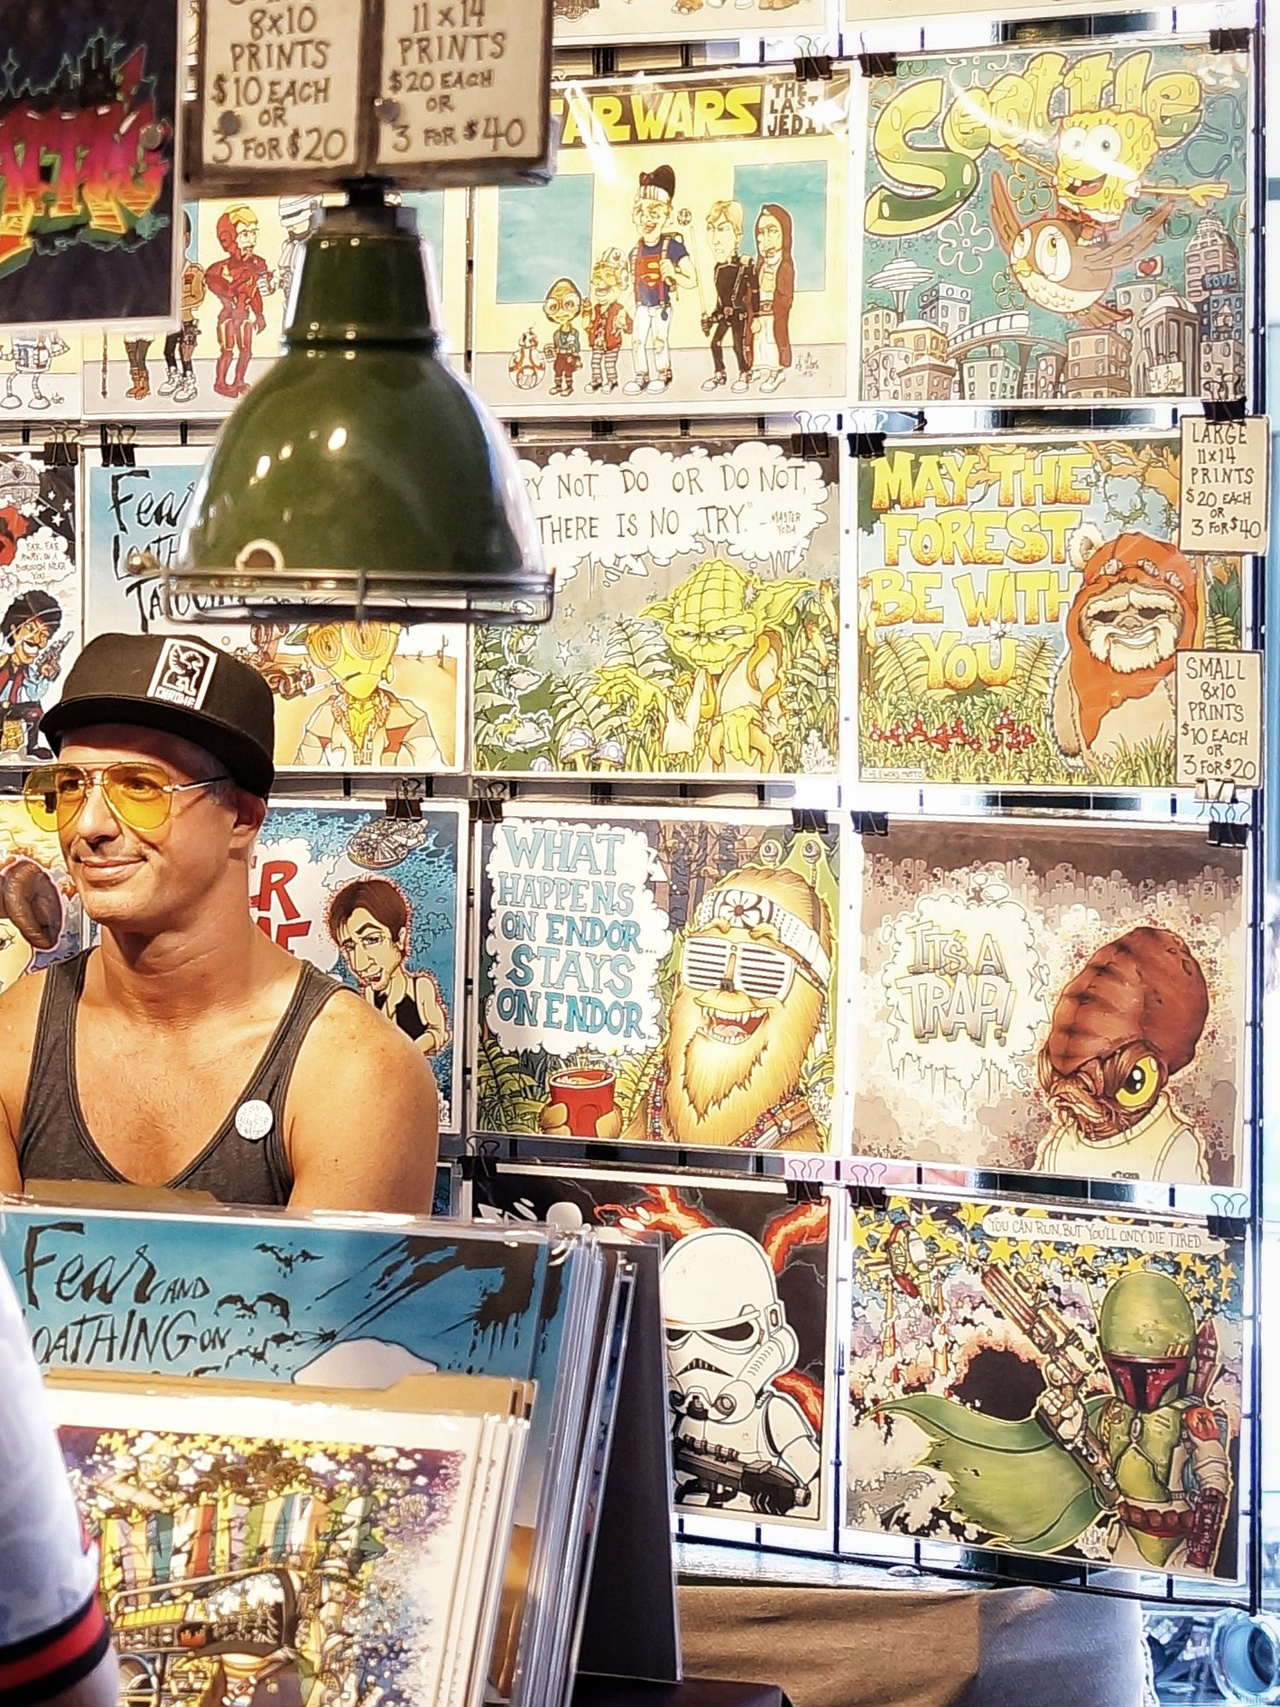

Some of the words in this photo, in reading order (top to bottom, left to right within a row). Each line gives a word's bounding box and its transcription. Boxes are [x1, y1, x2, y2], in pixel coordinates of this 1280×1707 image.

[249, 6, 317, 41] 8x10
[230, 40, 331, 72] PRINTS
[398, 31, 506, 66] PRINTS
[210, 74, 262, 107] $10
[268, 77, 330, 106] EACH
[389, 69, 434, 94] $20
[440, 69, 494, 90] EACH
[772, 82, 807, 99] THE
[258, 106, 288, 127] OR
[426, 95, 455, 113] OR
[631, 86, 762, 140] WARS
[242, 137, 283, 160] FOR
[287, 128, 346, 162] $20
[392, 124, 411, 152] 3
[423, 126, 457, 146] FOR
[463, 117, 525, 152] $40
[1192, 422, 1247, 445] LARGE
[1198, 447, 1236, 464] 11x14
[619, 469, 649, 494] DO
[672, 467, 704, 495] OR
[720, 464, 749, 491] DO
[870, 451, 979, 510] MAY
[989, 453, 1093, 507] THE
[1191, 467, 1254, 484] PRINTS
[1186, 487, 1217, 507] $20
[1222, 491, 1251, 505] EACH
[1210, 507, 1225, 518] OR
[535, 514, 599, 544] THERE
[616, 513, 638, 538] IS
[650, 506, 680, 538] NO
[880, 508, 1082, 566] FOREST
[1191, 519, 1204, 536] 3
[1209, 522, 1229, 534] FOR
[1230, 516, 1261, 539] $40
[867, 568, 944, 626] BE
[952, 568, 1083, 626] WITH
[913, 630, 1019, 690] YOU
[1186, 657, 1246, 680] SMALL
[1200, 681, 1236, 700] 8x10
[1188, 701, 1244, 722] PRINTS
[1181, 721, 1208, 745] $10
[1212, 728, 1248, 745] EACH
[1207, 744, 1224, 756] OR
[1183, 754, 1197, 775] 3
[1200, 760, 1223, 775] FOR
[1224, 758, 1256, 780] $20
[501, 824, 625, 876] WHAT
[498, 872, 636, 917] HAPPENS
[500, 911, 537, 943] ON
[505, 944, 636, 999] STAYS
[974, 933, 1009, 982] A
[496, 987, 539, 1028] ON
[895, 971, 1017, 1048] TRAP!
[988, 1217, 1009, 1232] YOU
[1012, 1219, 1033, 1234] CAN
[1063, 1223, 1083, 1237] BUT
[1120, 1229, 1147, 1243] ONLY
[1149, 1231, 1166, 1245] DIE
[15, 1221, 167, 1310] Fear
[160, 1276, 210, 1305] AND
[28, 1309, 198, 1365] OATHING
[199, 1327, 232, 1353] ON
